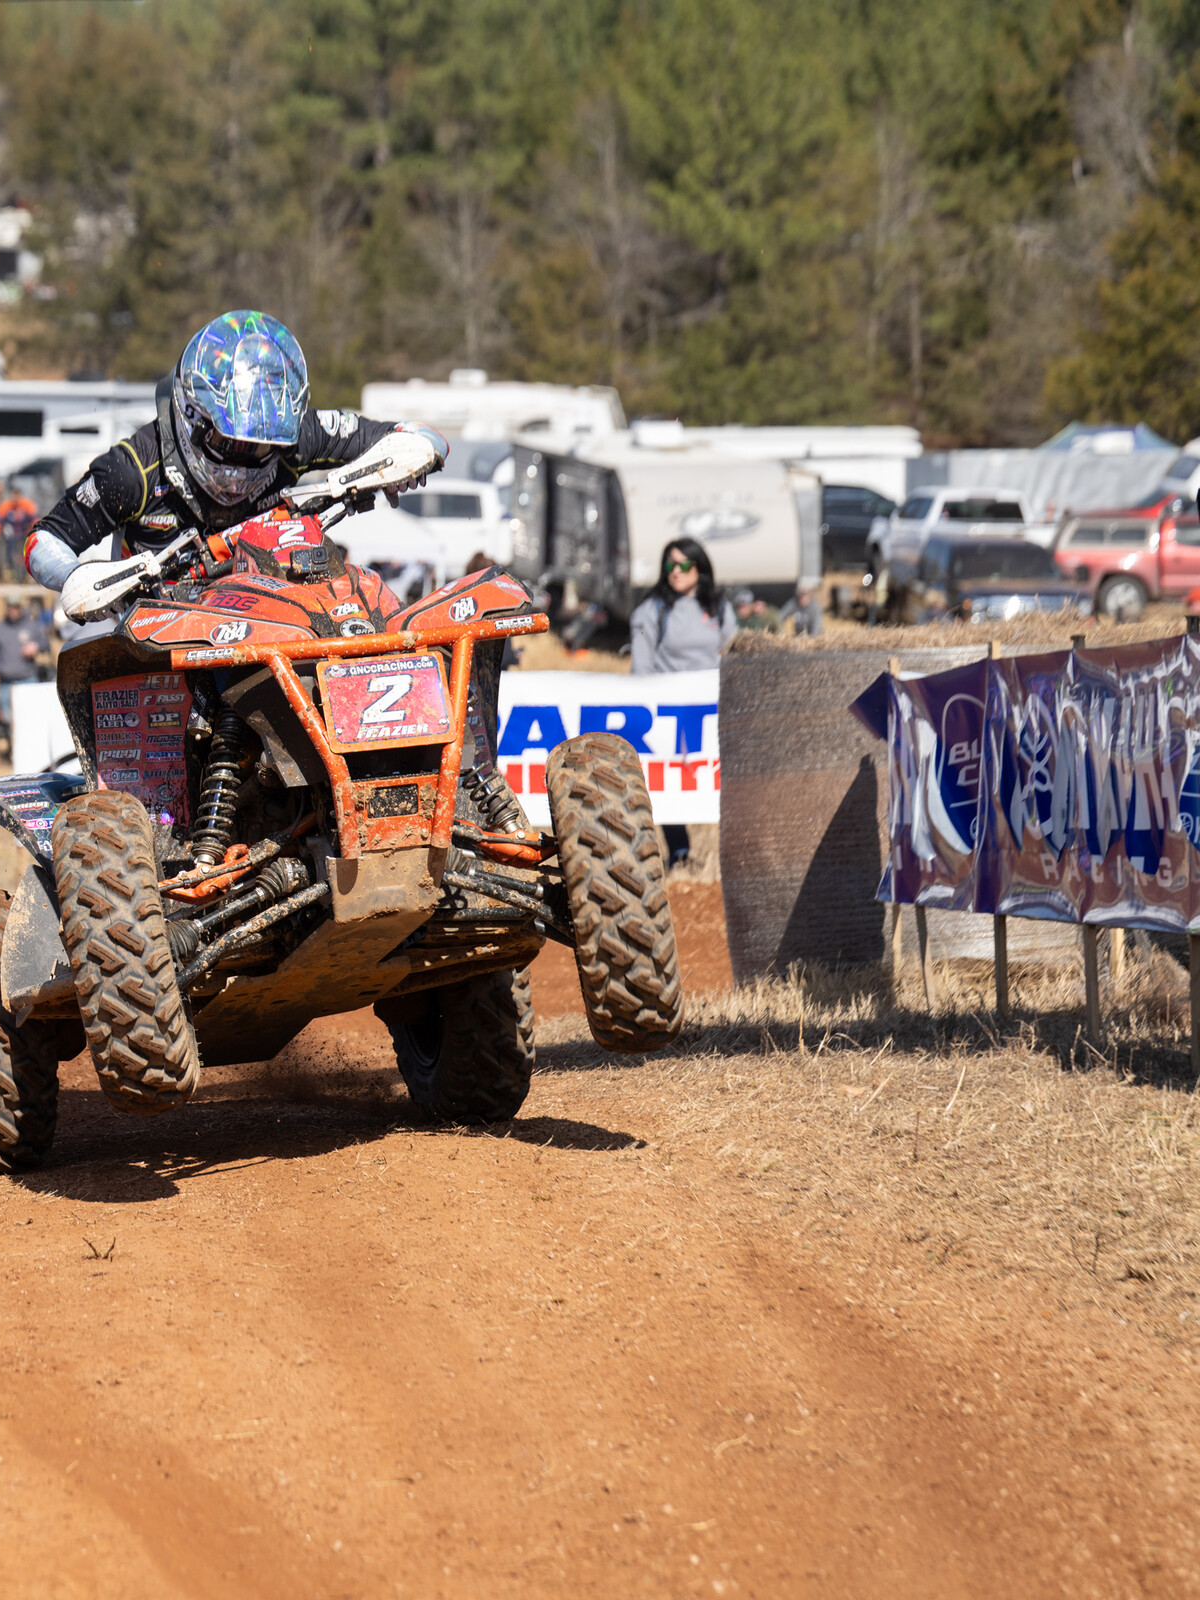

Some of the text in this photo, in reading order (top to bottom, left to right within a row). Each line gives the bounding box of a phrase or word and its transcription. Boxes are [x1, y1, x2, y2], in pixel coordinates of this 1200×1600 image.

[278, 524, 305, 546] 2
[206, 594, 259, 611] GBC
[452, 599, 475, 620] 784
[215, 621, 248, 643] 784
[349, 660, 434, 676] GNCCRACING.COM
[139, 674, 183, 690] JETT
[94, 690, 139, 702] FRAZIER
[361, 674, 413, 725] 2
[96, 700, 139, 709] AUTO SALES
[150, 713, 179, 722] DP
[97, 732, 141, 741] CHUCK'S
[357, 723, 428, 738] FRAZIER
[497, 704, 718, 756] ART
